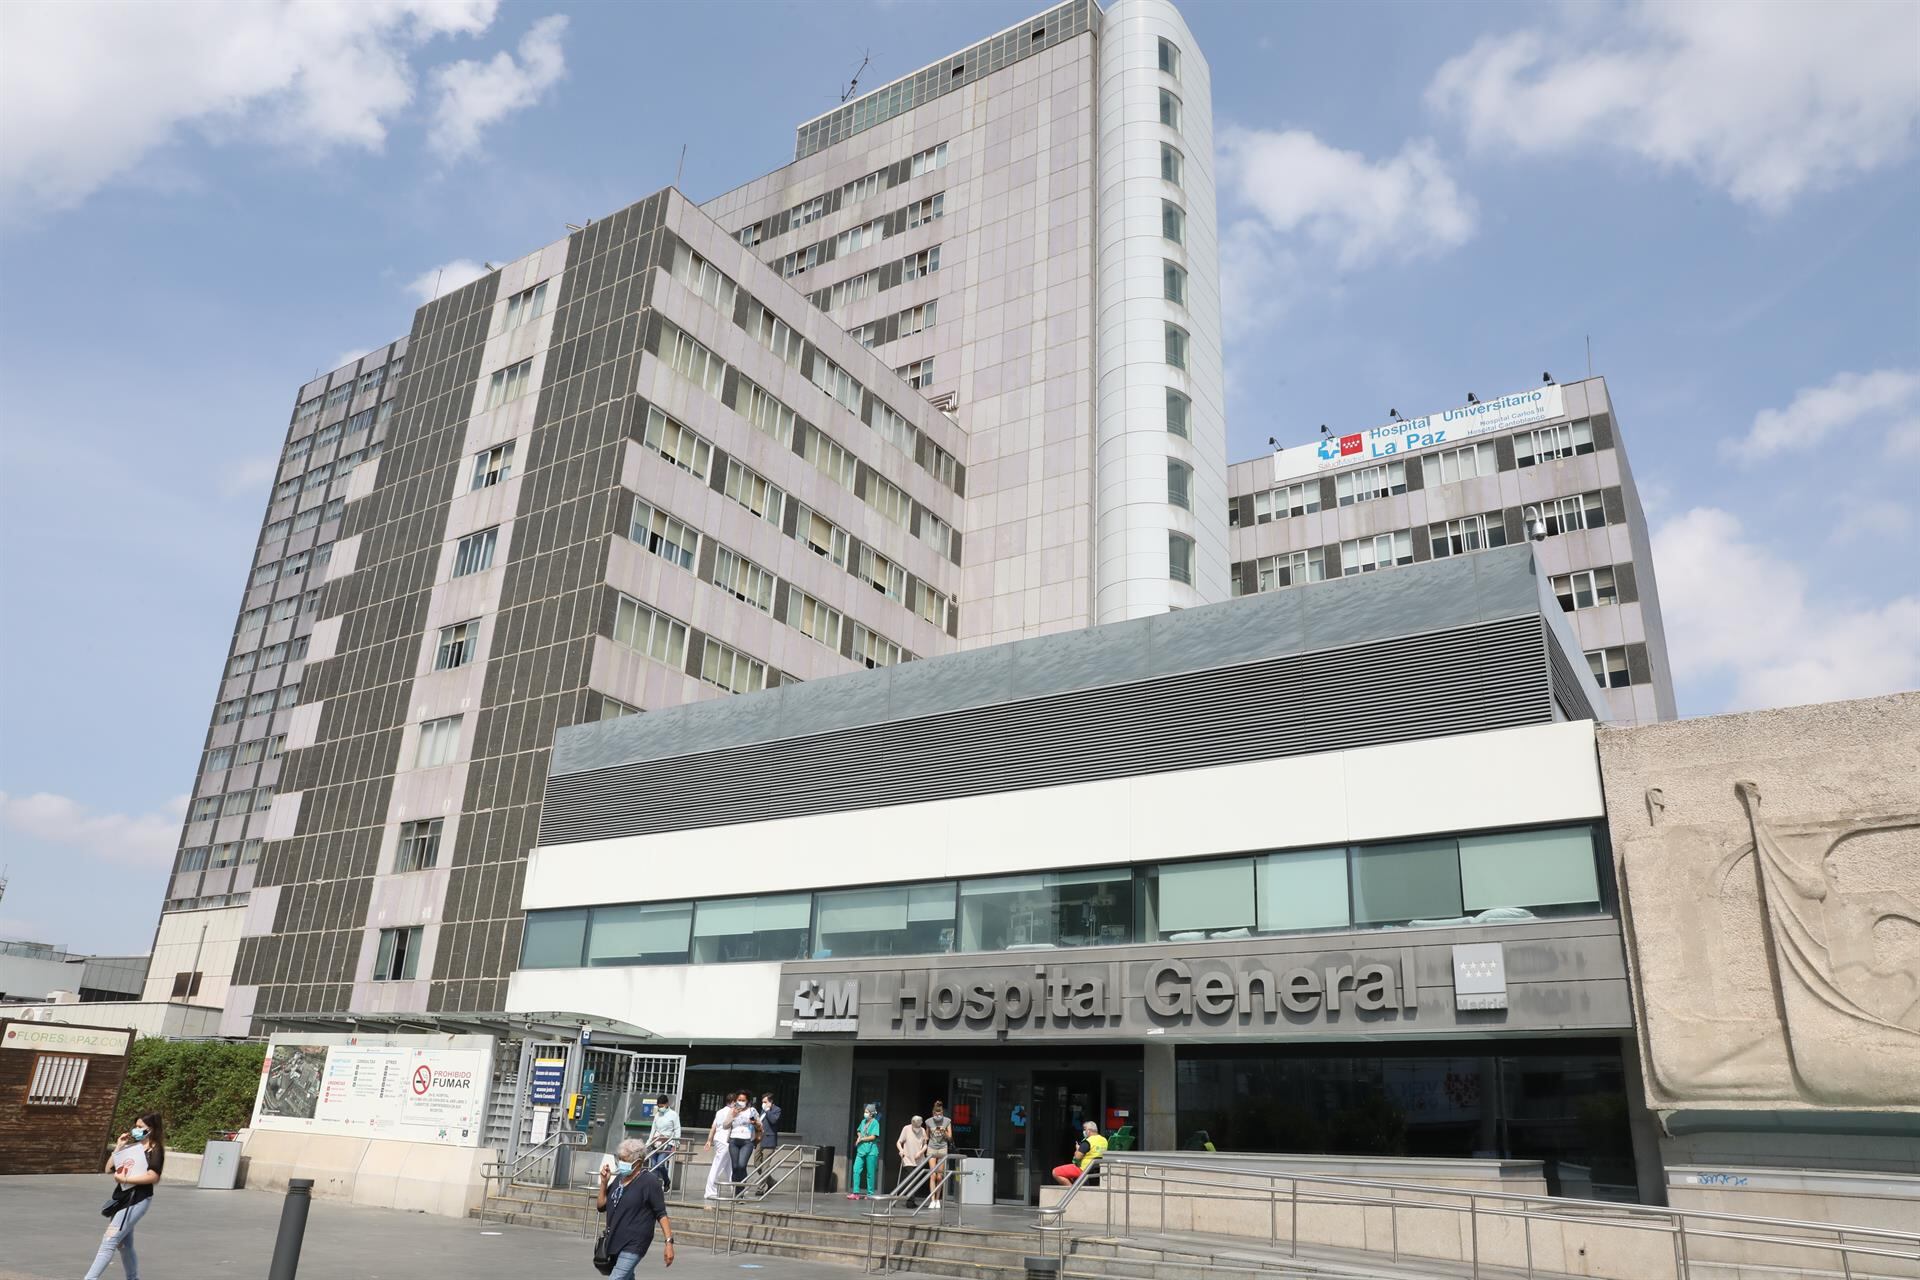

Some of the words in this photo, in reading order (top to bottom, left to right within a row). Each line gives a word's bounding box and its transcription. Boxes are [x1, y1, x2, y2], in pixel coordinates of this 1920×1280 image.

[1370, 415, 1431, 440] Hospital
[1442, 392, 1542, 422] Universitario
[1467, 424, 1497, 436] Hospital
[1498, 414, 1546, 430] Cantoblanco
[1480, 414, 1510, 427] Hospital
[1511, 409, 1535, 421] Carlos
[1371, 441, 1397, 458] La
[1406, 430, 1447, 449] Paz
[892, 963, 1122, 1044] Hospital
[1143, 948, 1418, 1019] General
[1457, 997, 1507, 1010] Madrid
[432, 1077, 471, 1089] FUMAR
[433, 1070, 472, 1079] PROHIBIDO
